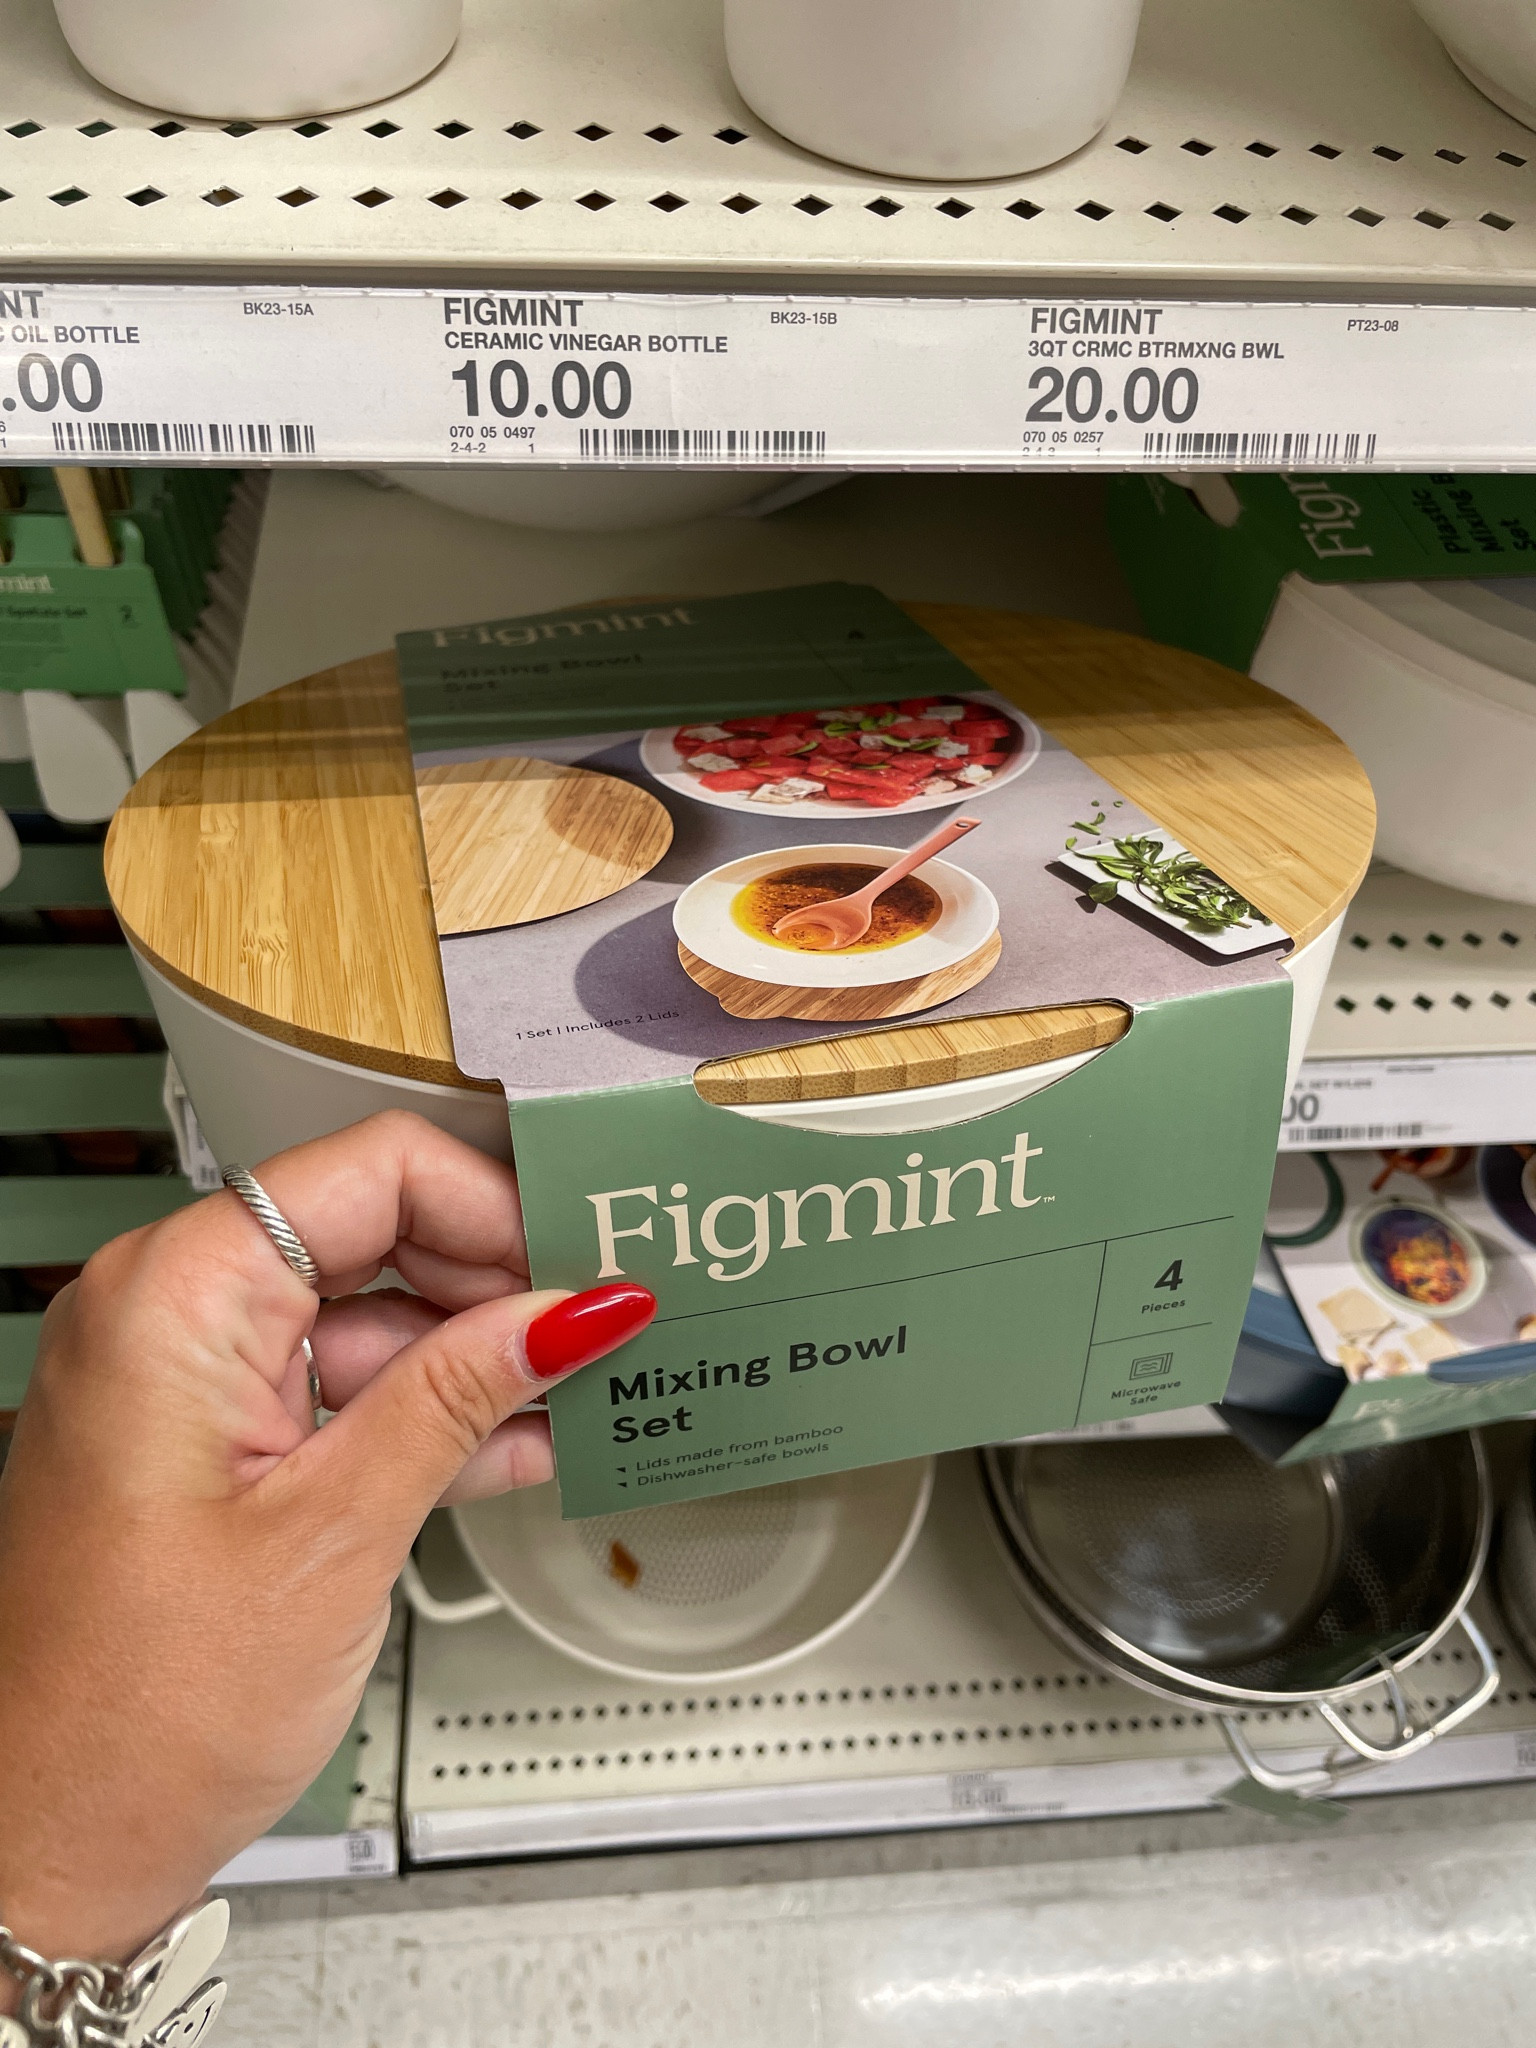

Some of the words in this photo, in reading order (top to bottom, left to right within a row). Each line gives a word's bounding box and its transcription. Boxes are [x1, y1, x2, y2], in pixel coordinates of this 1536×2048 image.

[243, 302, 314, 316] BK23-15A
[443, 297, 583, 327] FIGMINT
[770, 311, 837, 325] BK23-15B
[1030, 307, 1163, 335] FIGMINT
[1347, 319, 1399, 332] PT23-08
[12, 325, 48, 342] OIL
[54, 325, 140, 343] BOTTLE
[444, 331, 543, 351] CERAMIC
[549, 333, 642, 352] VINEGAR
[648, 335, 728, 353] BOTTLE
[1028, 340, 1067, 358] 3QT
[1072, 340, 1132, 358] CRMC
[1138, 341, 1236, 359] BTRMXNG
[1242, 342, 1285, 359] BWL
[451, 359, 632, 419] 10.00
[1025, 366, 1199, 424] 20.00
[450, 426, 474, 438] 070
[480, 426, 497, 438] 05
[503, 426, 535, 439] 0497
[1023, 431, 1046, 443] 070
[1052, 431, 1067, 443] 05
[1074, 431, 1104, 443] 0257
[451, 443, 486, 454] 2-4-2
[527, 1028, 552, 1039] Set
[566, 1018, 631, 1034] Includes
[635, 1015, 645, 1023] 2
[649, 1011, 680, 1021] Lids
[585, 1132, 1043, 1282] Figmint
[1153, 1259, 1183, 1291] 4
[1141, 1299, 1186, 1314] Pieces
[609, 1353, 771, 1405] Mixing
[788, 1325, 907, 1373] Bowl
[1110, 1380, 1182, 1400] Microwave
[1130, 1394, 1158, 1406] Safe
[612, 1406, 693, 1444] Set
[636, 1456, 671, 1472] Lids
[676, 1447, 724, 1464] made
[729, 1437, 768, 1453] from
[774, 1425, 844, 1445] bamboo
[637, 1451, 777, 1486] Dishwasher-safe
[782, 1441, 830, 1459] bowls
